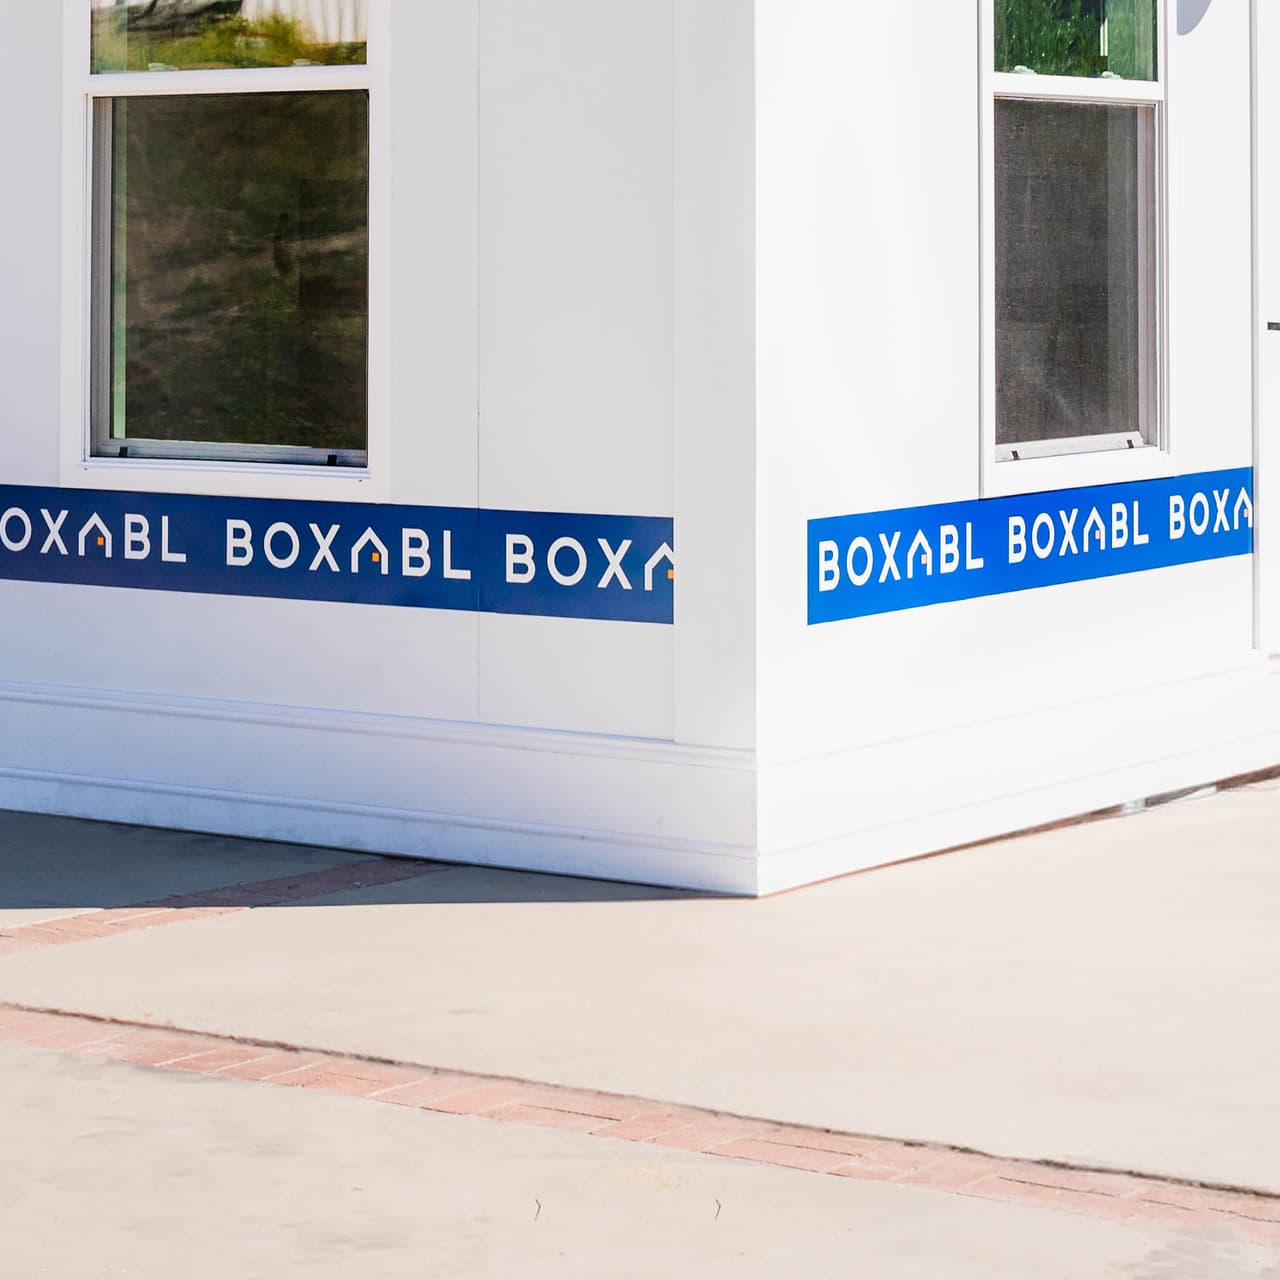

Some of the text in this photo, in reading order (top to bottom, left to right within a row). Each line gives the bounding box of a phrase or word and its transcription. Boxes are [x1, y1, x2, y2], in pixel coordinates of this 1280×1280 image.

[227, 519, 472, 580] BOXABL
[819, 486, 1253, 591] BOXABL BOXABL BOXA
